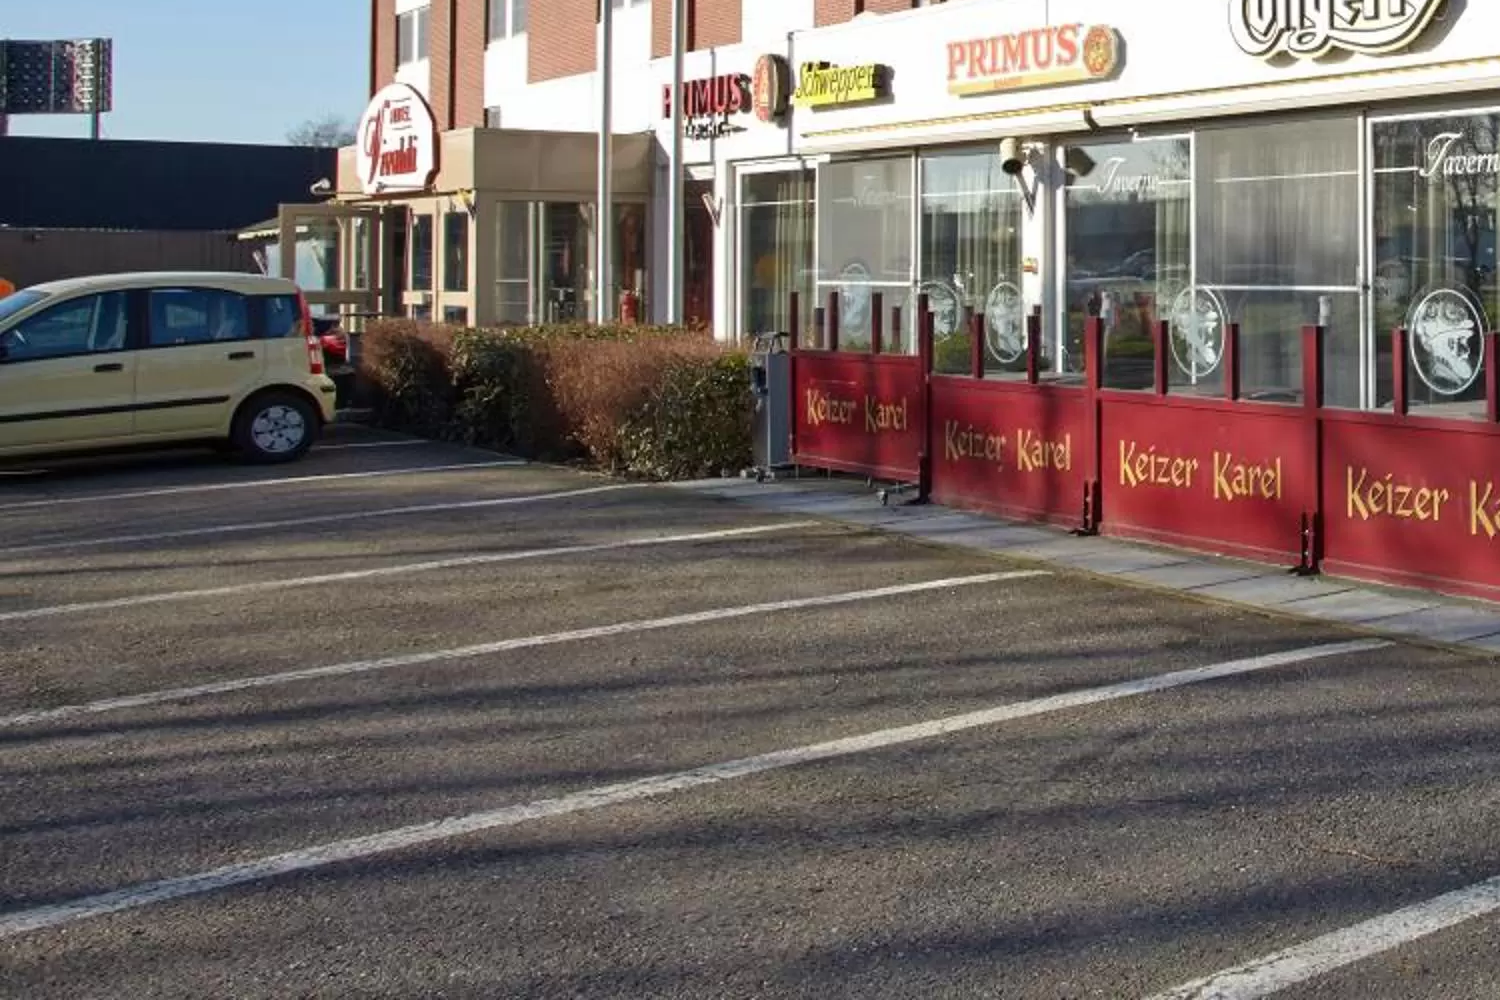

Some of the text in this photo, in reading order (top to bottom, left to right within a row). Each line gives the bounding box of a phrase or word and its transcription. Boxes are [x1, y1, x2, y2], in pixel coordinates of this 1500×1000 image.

[947, 23, 1080, 81] PRIMUS
[662, 73, 747, 120] PIMUS
[945, 421, 1070, 472] Keizer Karel
[1119, 440, 1280, 501] Keizer Karel
[1347, 465, 1449, 520] Keizer
